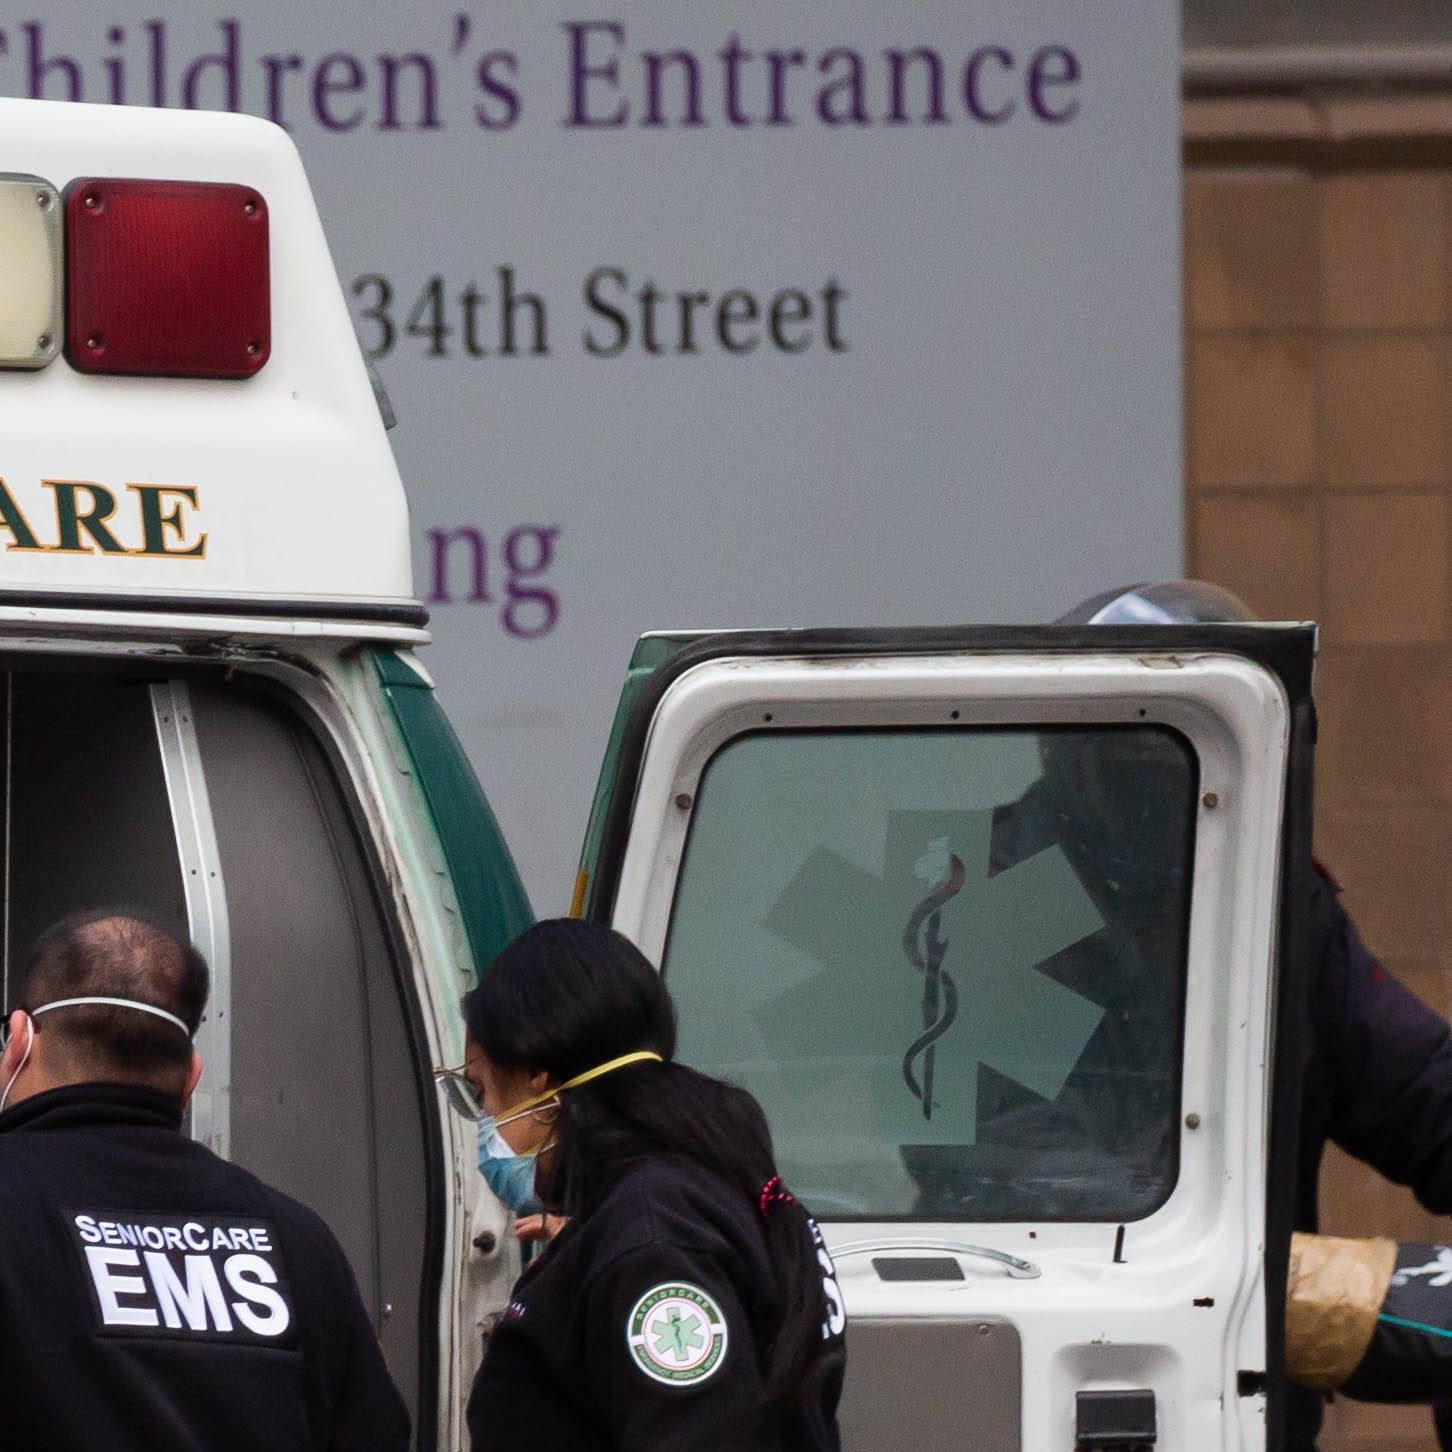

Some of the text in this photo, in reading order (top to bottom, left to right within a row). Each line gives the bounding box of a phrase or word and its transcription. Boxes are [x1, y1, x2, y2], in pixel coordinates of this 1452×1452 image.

[561, 20, 1083, 130] Entrance
[352, 266, 848, 360] 34th Street
[424, 524, 561, 639] ng
[84, 1246, 290, 1336] EMS
